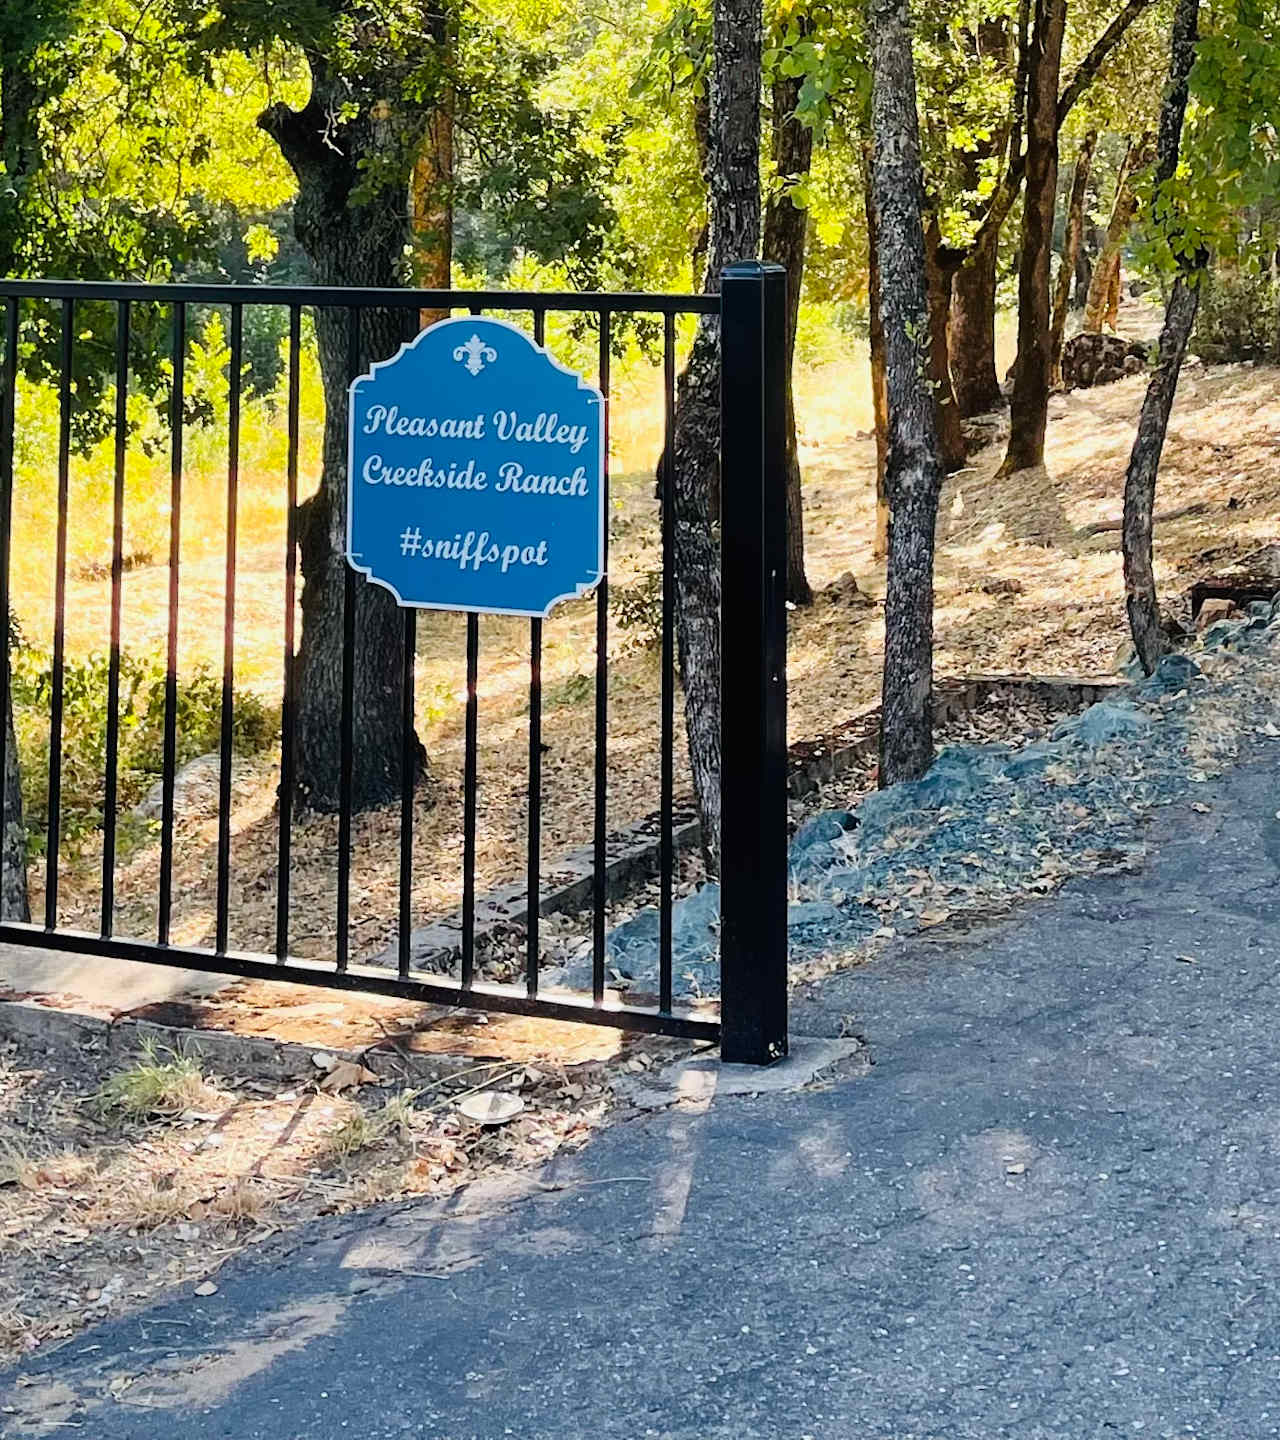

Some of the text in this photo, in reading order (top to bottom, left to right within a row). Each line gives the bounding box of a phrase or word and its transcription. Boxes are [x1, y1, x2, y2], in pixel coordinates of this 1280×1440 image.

[363, 404, 589, 454] Pleasant Valley
[362, 454, 589, 497] Creekside Ranch
[400, 526, 548, 572] #sniffspot
